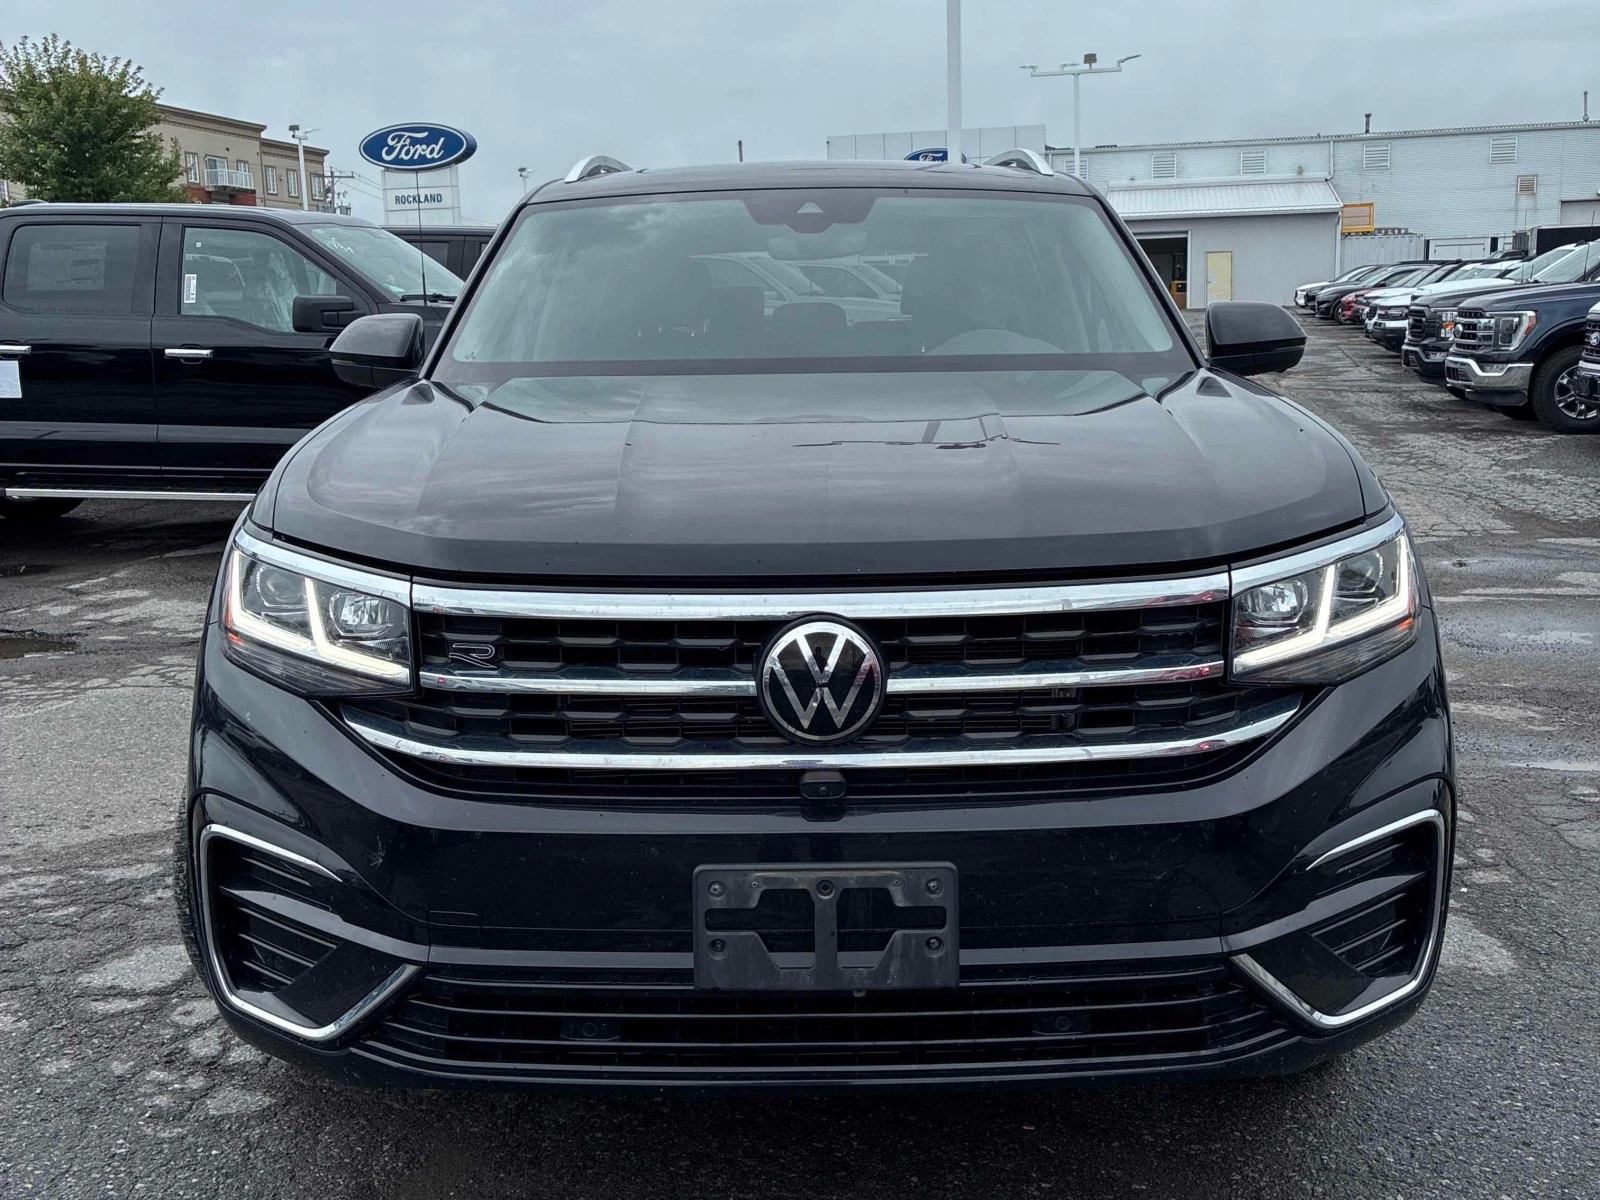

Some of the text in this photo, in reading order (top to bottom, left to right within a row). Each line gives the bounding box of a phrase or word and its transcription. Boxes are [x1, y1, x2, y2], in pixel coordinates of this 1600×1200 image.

[381, 131, 445, 161] Ford
[394, 193, 443, 205] ROCKLAND
[448, 643, 498, 669] R
